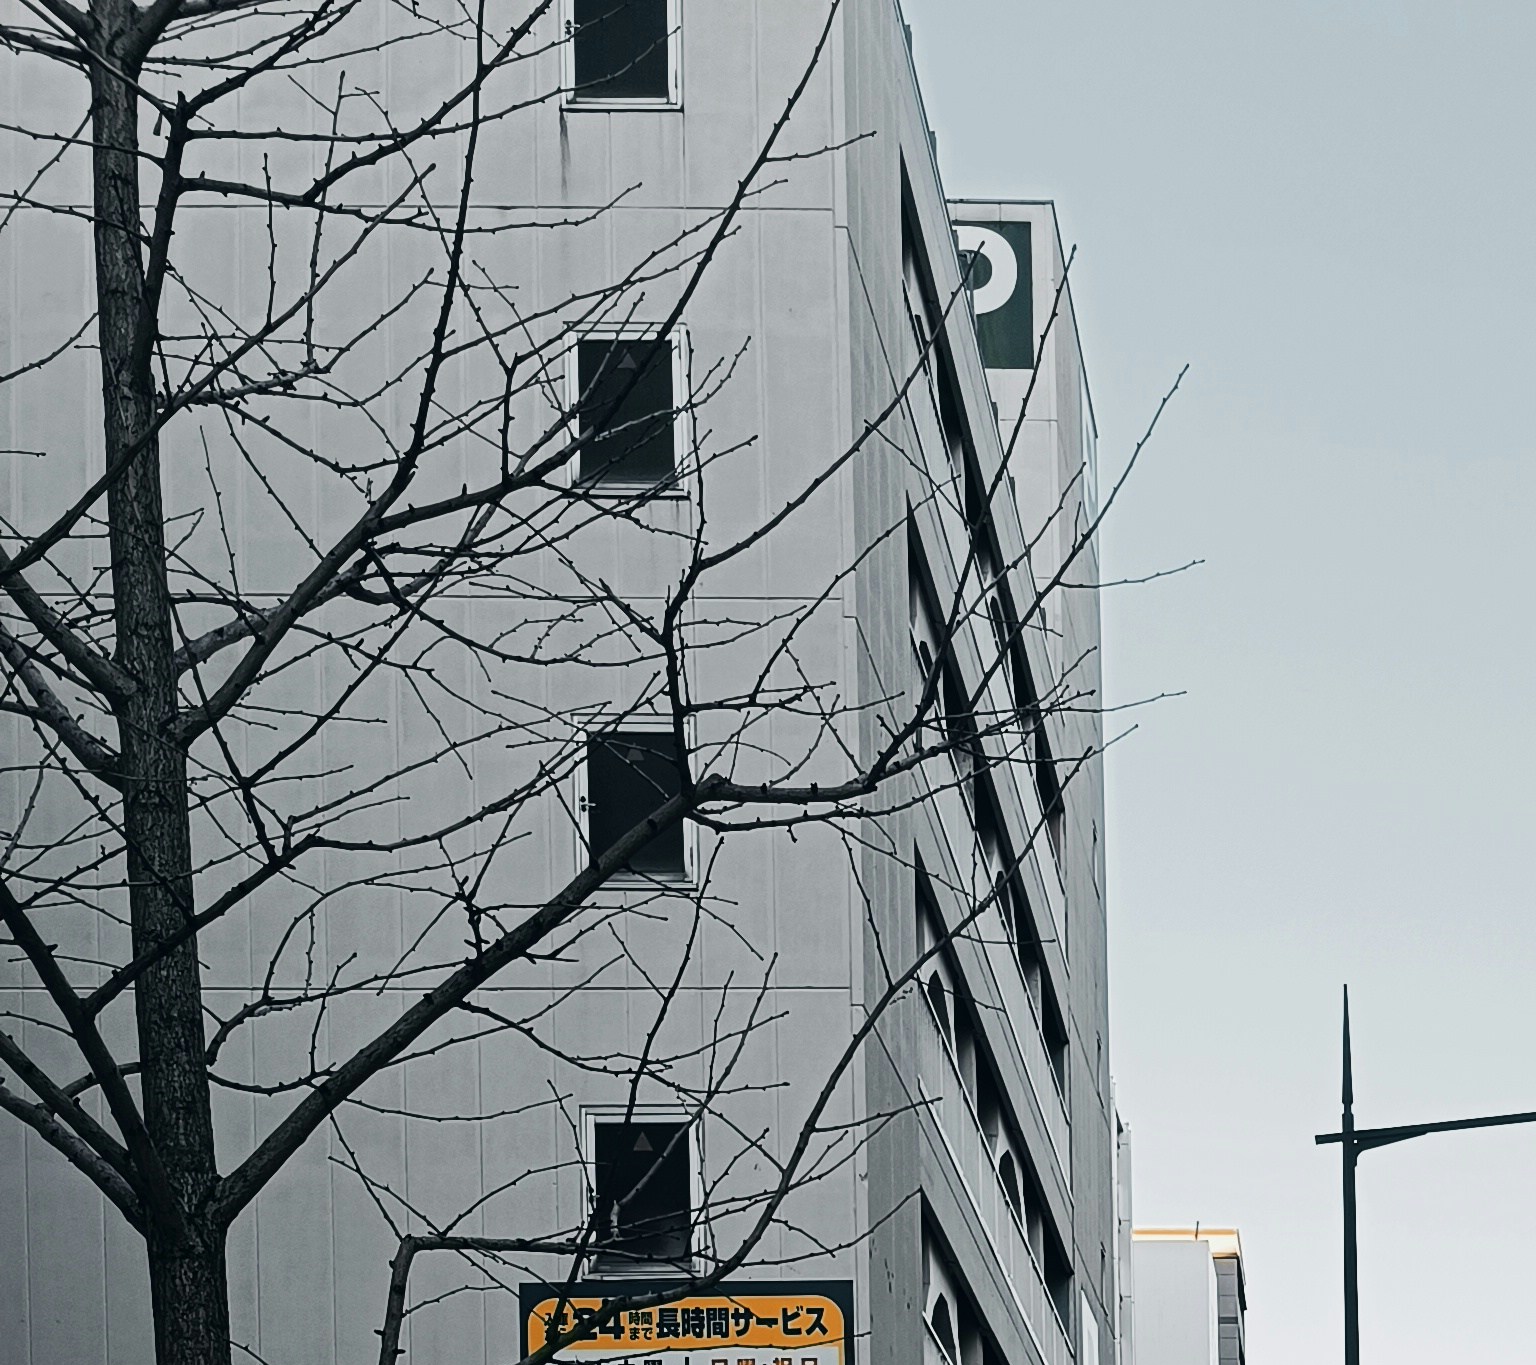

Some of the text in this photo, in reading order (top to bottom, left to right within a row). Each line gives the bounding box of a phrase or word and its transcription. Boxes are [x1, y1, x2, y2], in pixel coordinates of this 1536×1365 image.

[656, 1305, 829, 1339] 長時間サービス
